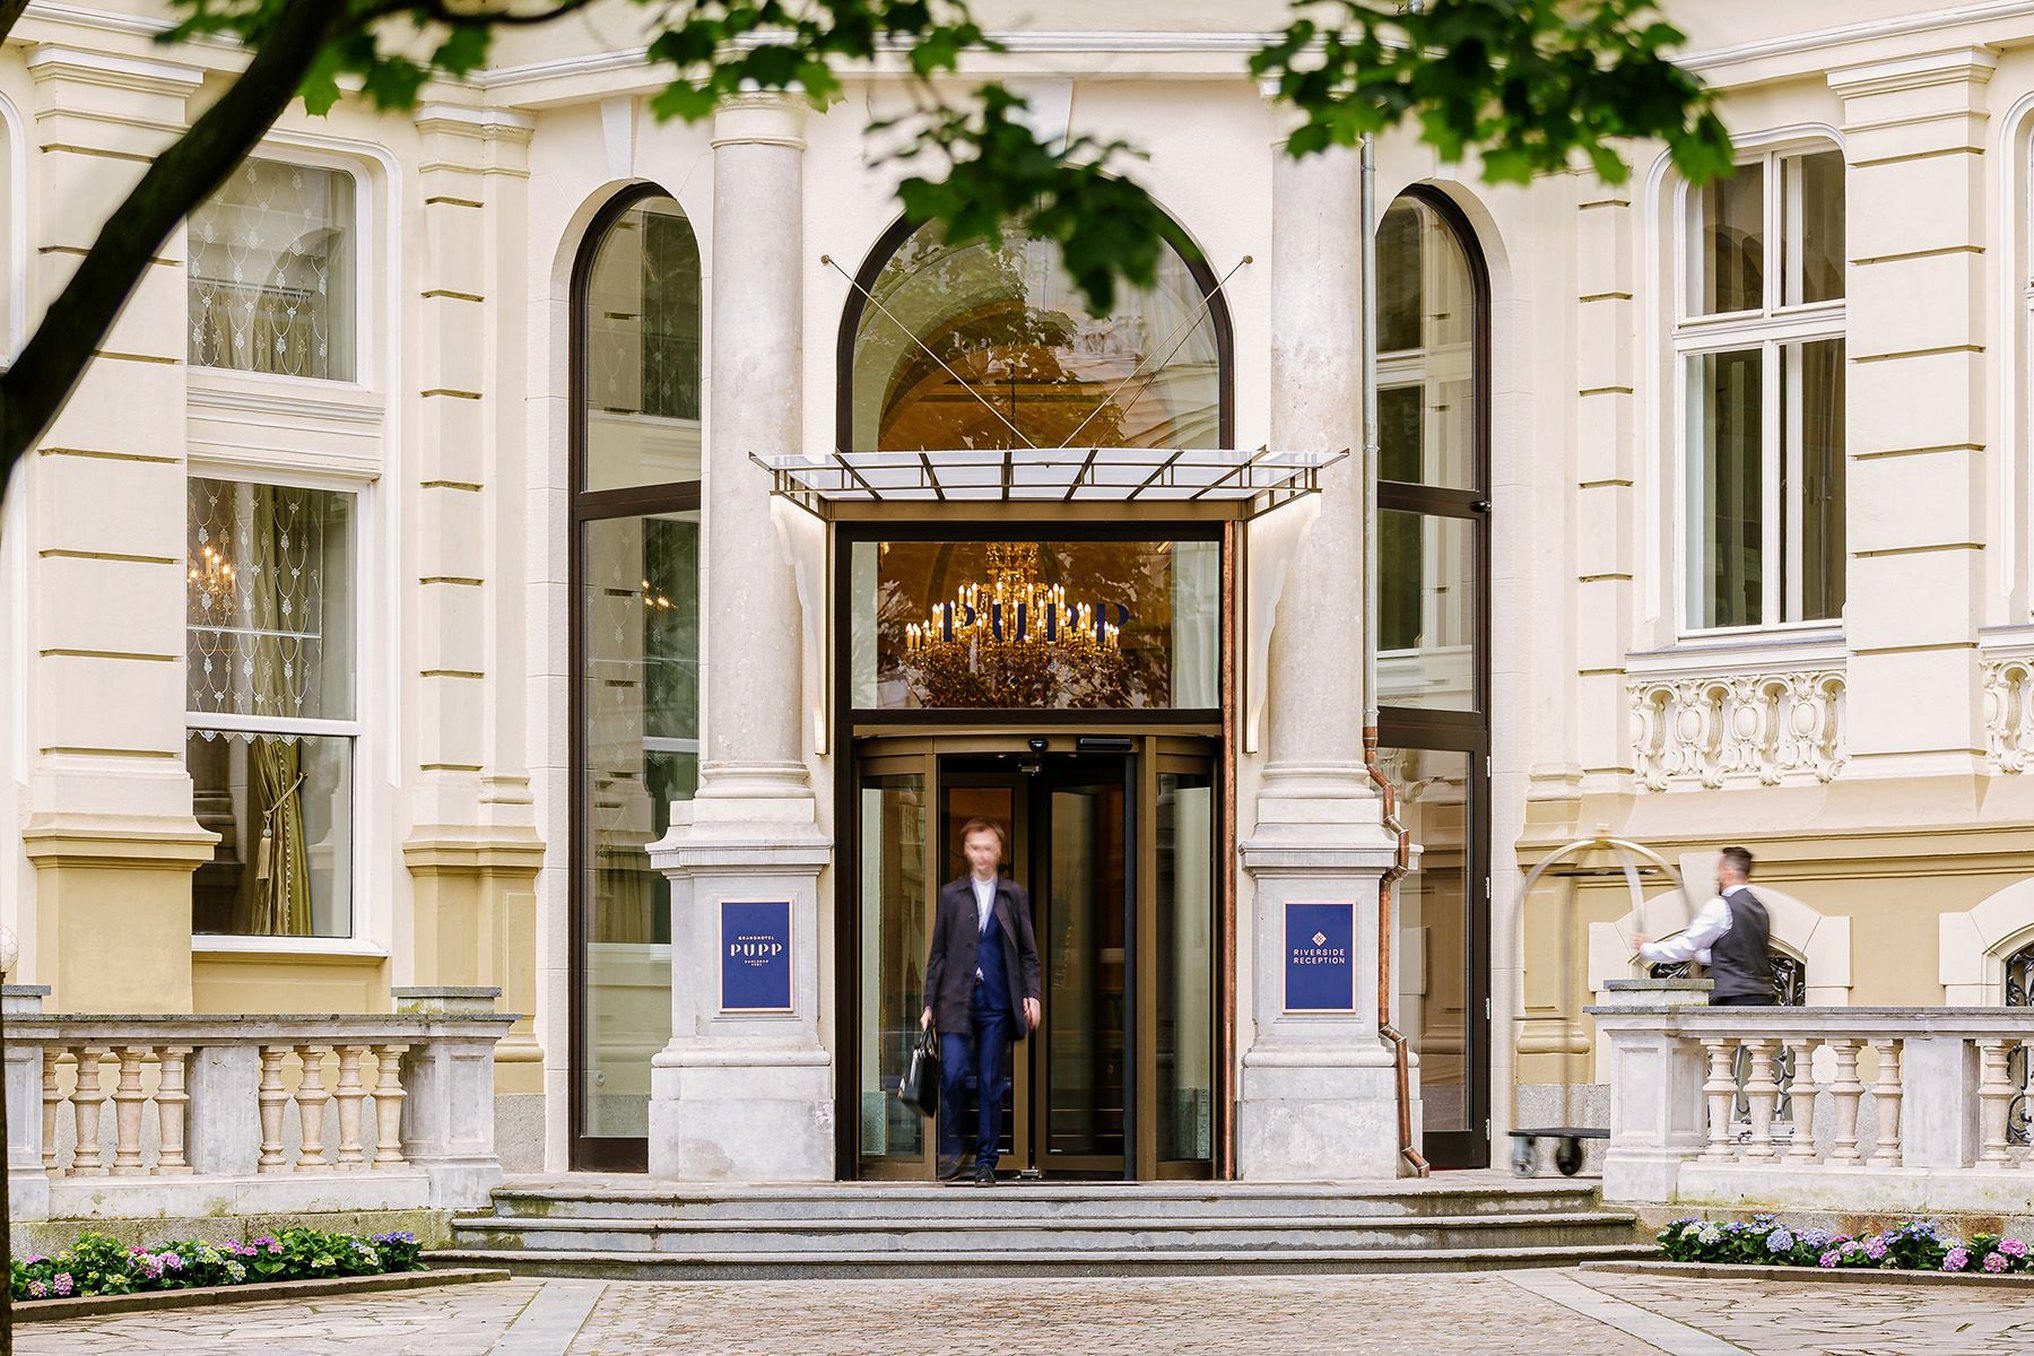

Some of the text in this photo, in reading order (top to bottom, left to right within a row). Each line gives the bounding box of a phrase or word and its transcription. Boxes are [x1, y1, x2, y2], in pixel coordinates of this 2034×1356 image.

[943, 603, 1130, 642] PUPP
[730, 943, 783, 957] PUPP
[1293, 948, 1345, 956] RIVERSIDE
